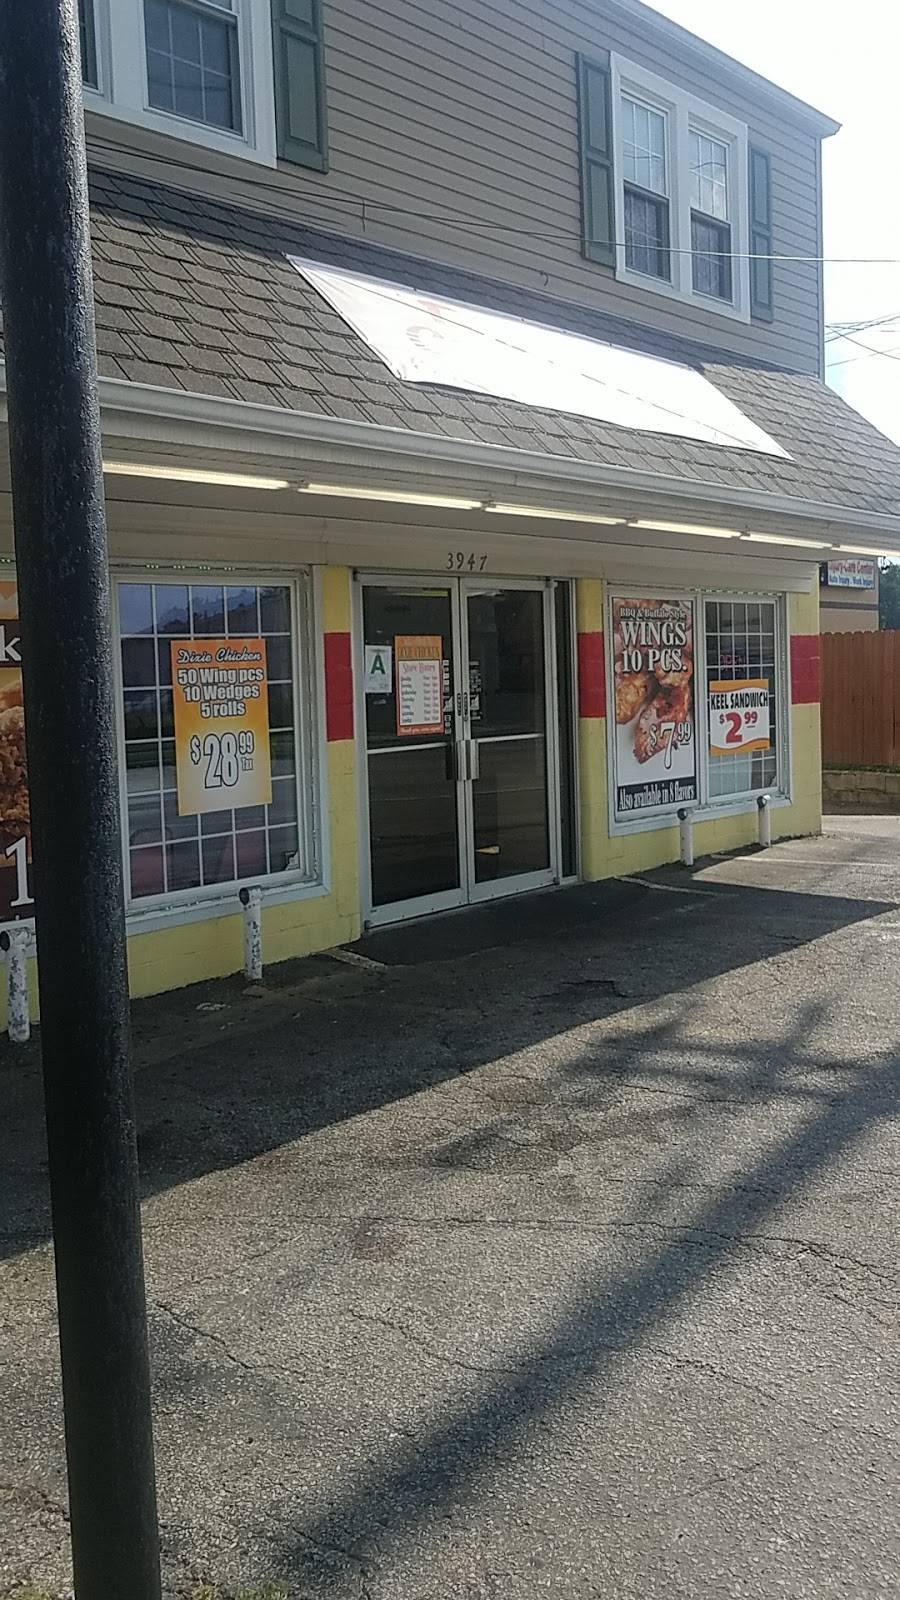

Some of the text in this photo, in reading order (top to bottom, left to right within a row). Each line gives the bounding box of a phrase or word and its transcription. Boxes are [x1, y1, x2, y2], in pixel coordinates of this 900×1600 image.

[446, 552, 488, 571] 3947
[620, 607, 636, 618] BBQ
[620, 620, 688, 647] WINGS
[177, 648, 262, 664] Dixie Chicken
[370, 654, 386, 675] A
[621, 648, 688, 673] 10 PCS.
[177, 667, 264, 685] 50 Wing pcs
[183, 684, 261, 702] 10 Wedges
[710, 691, 769, 710] KEEL SANDWICH
[200, 700, 246, 718] 5 rolls
[618, 787, 633, 810] Also
[633, 783, 661, 807] available
[661, 782, 669, 804] in
